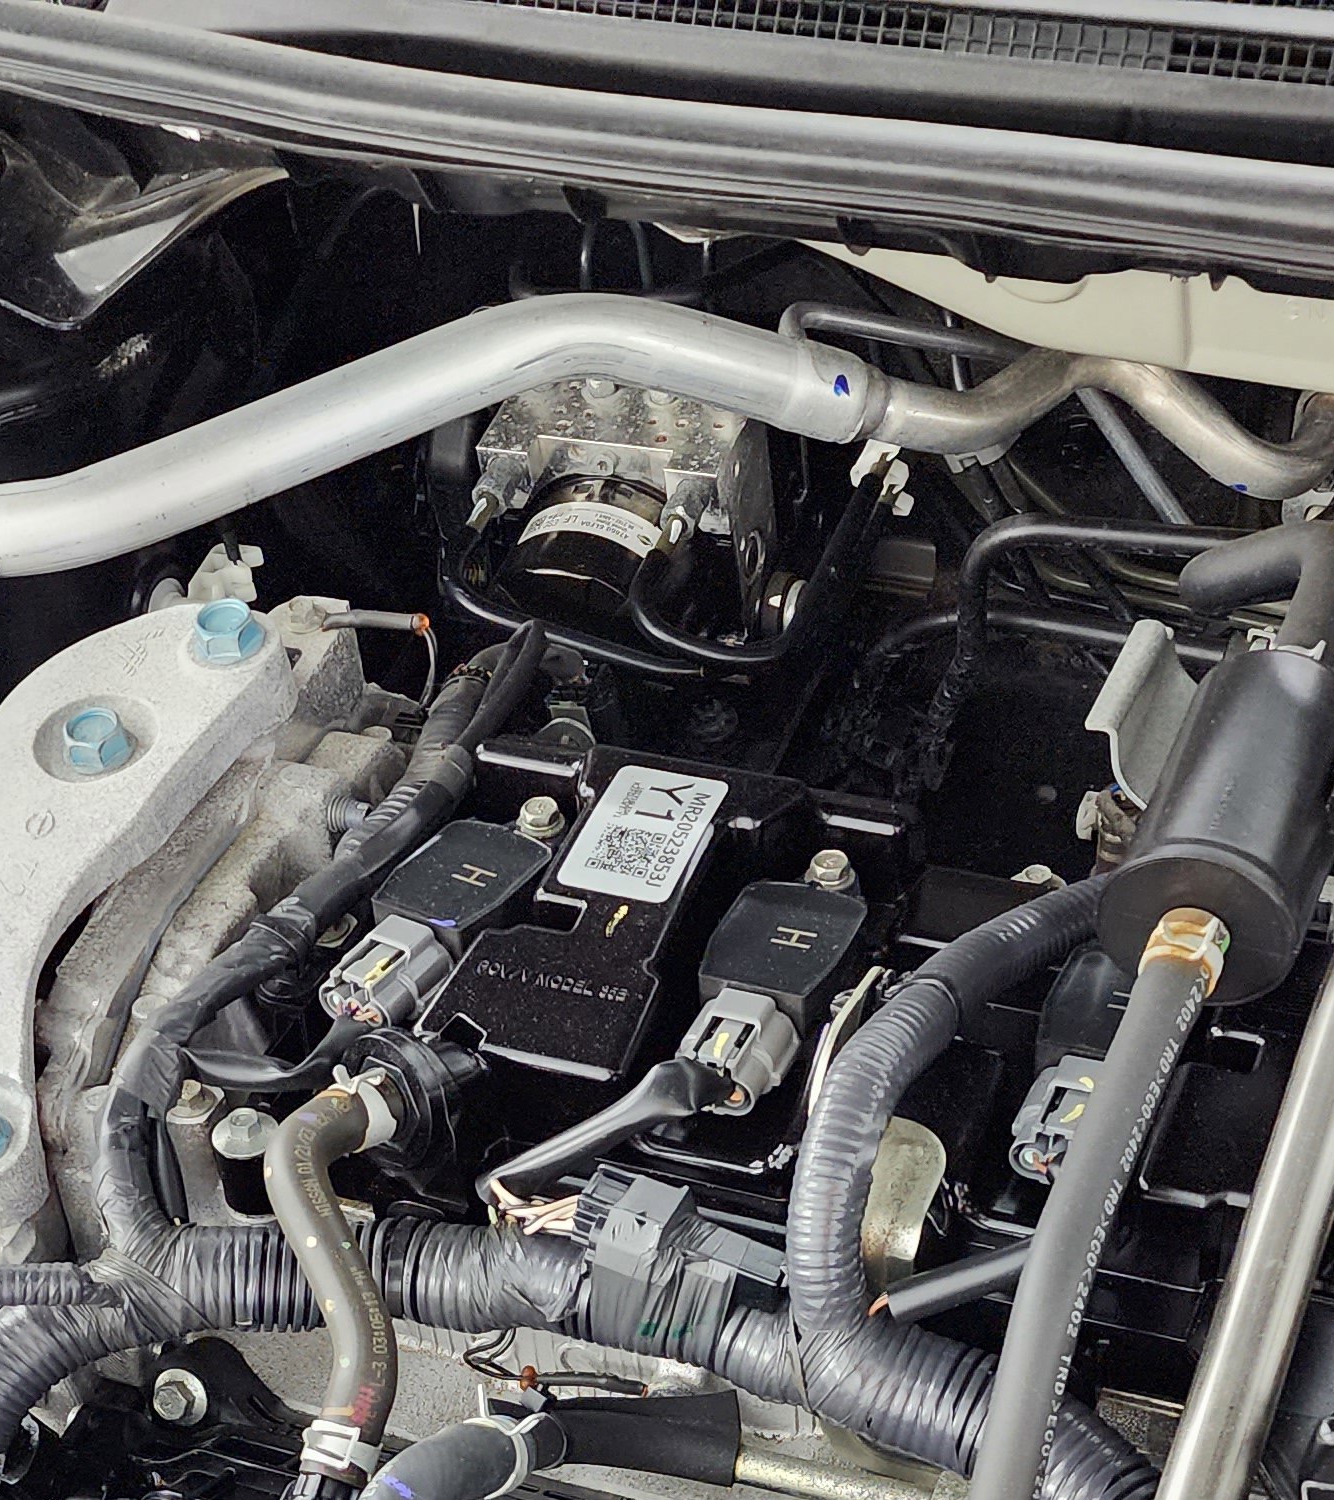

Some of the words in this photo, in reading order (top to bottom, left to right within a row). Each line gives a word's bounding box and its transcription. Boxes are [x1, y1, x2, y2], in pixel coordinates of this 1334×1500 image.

[645, 793, 711, 887] MR20523853J
[451, 861, 498, 887] H
[770, 926, 817, 949] H
